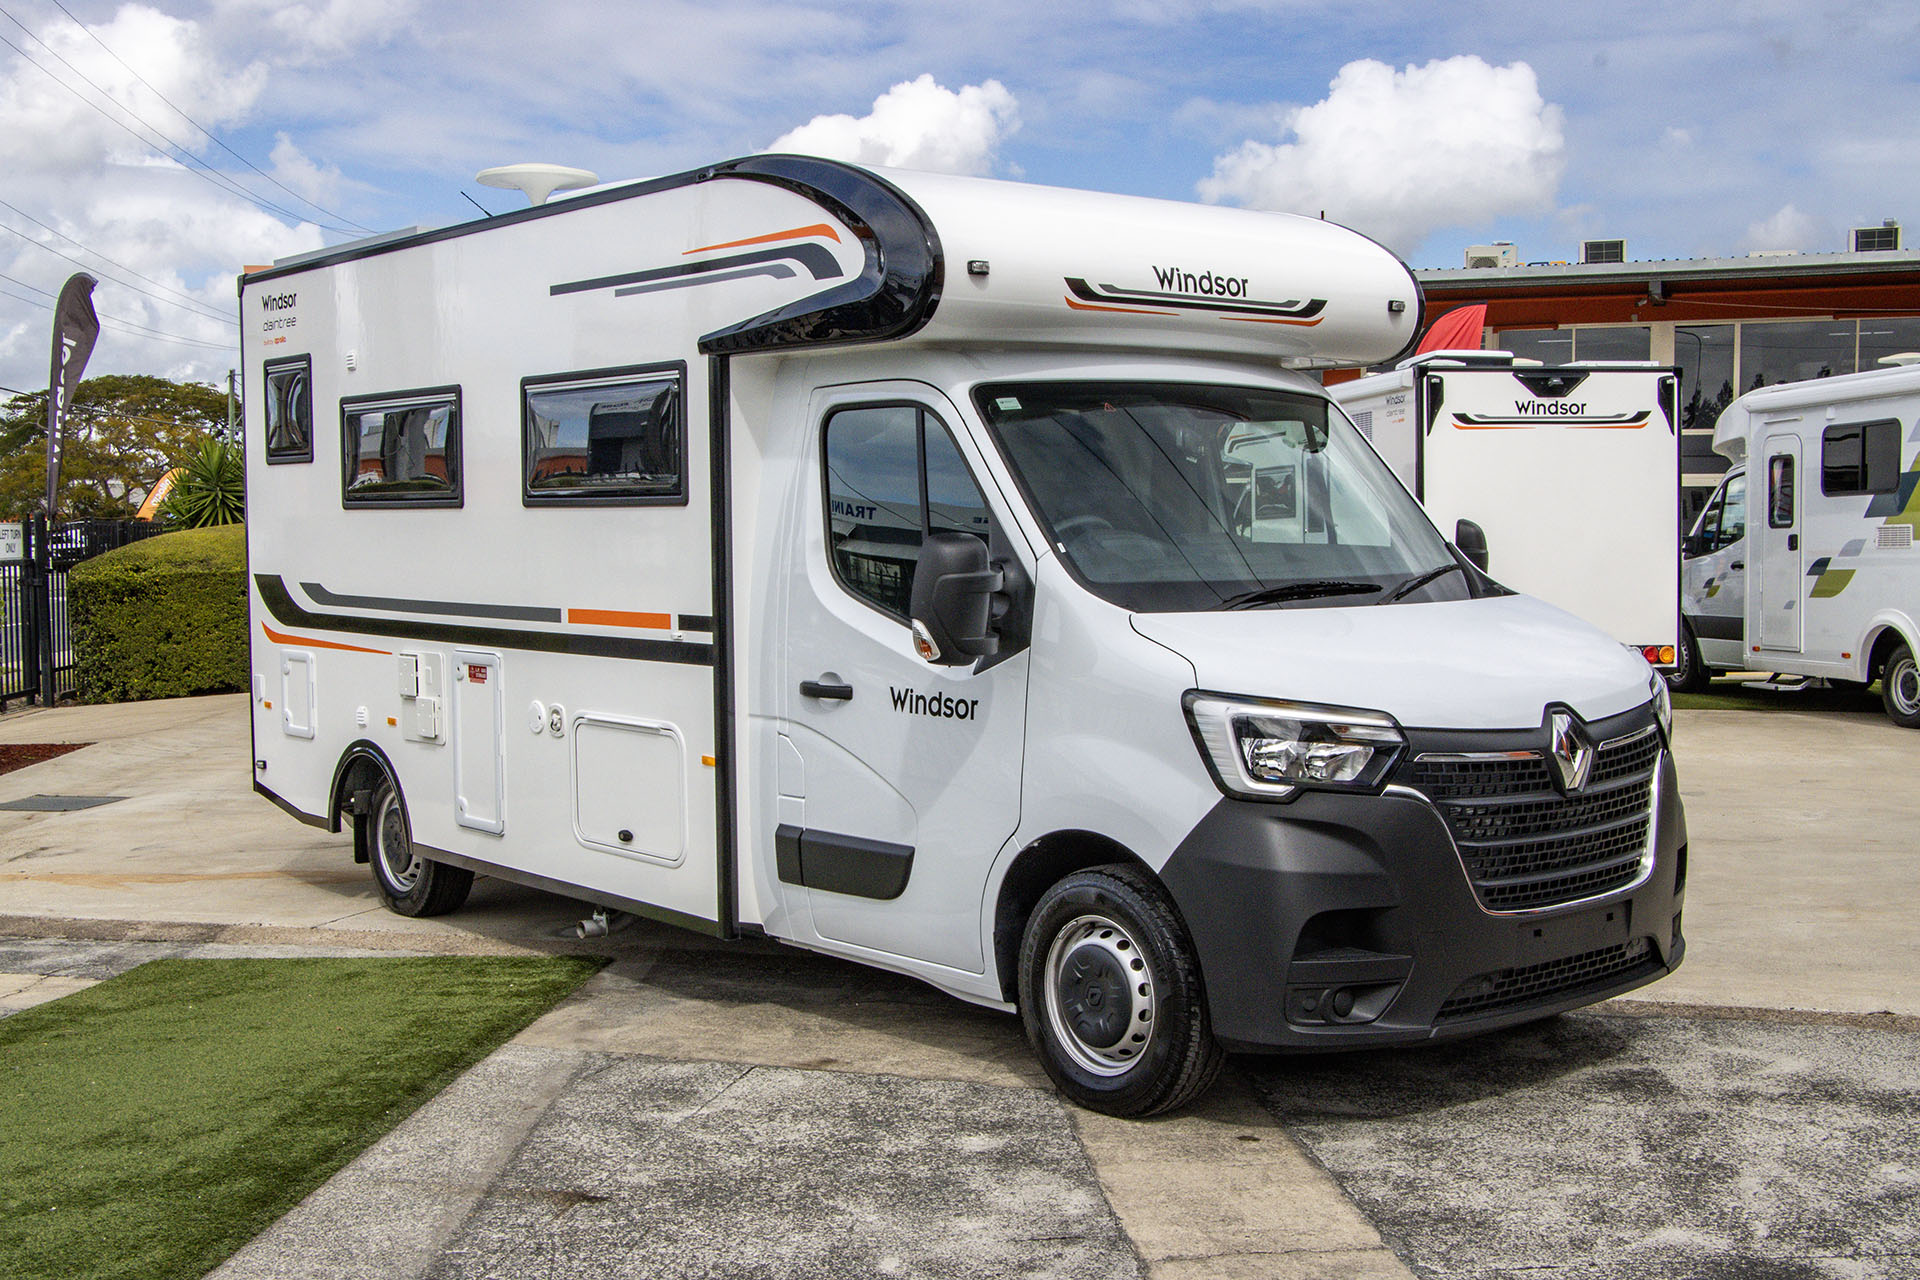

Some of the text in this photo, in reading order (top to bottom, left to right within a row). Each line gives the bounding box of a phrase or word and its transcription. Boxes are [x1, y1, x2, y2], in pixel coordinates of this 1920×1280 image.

[1152, 264, 1249, 298] Windsor
[262, 293, 297, 311] Windsor
[1514, 400, 1587, 416] Windsor
[10, 529, 22, 540] TURN
[6, 543, 16, 553] ONLY
[889, 686, 979, 721] Windsor
